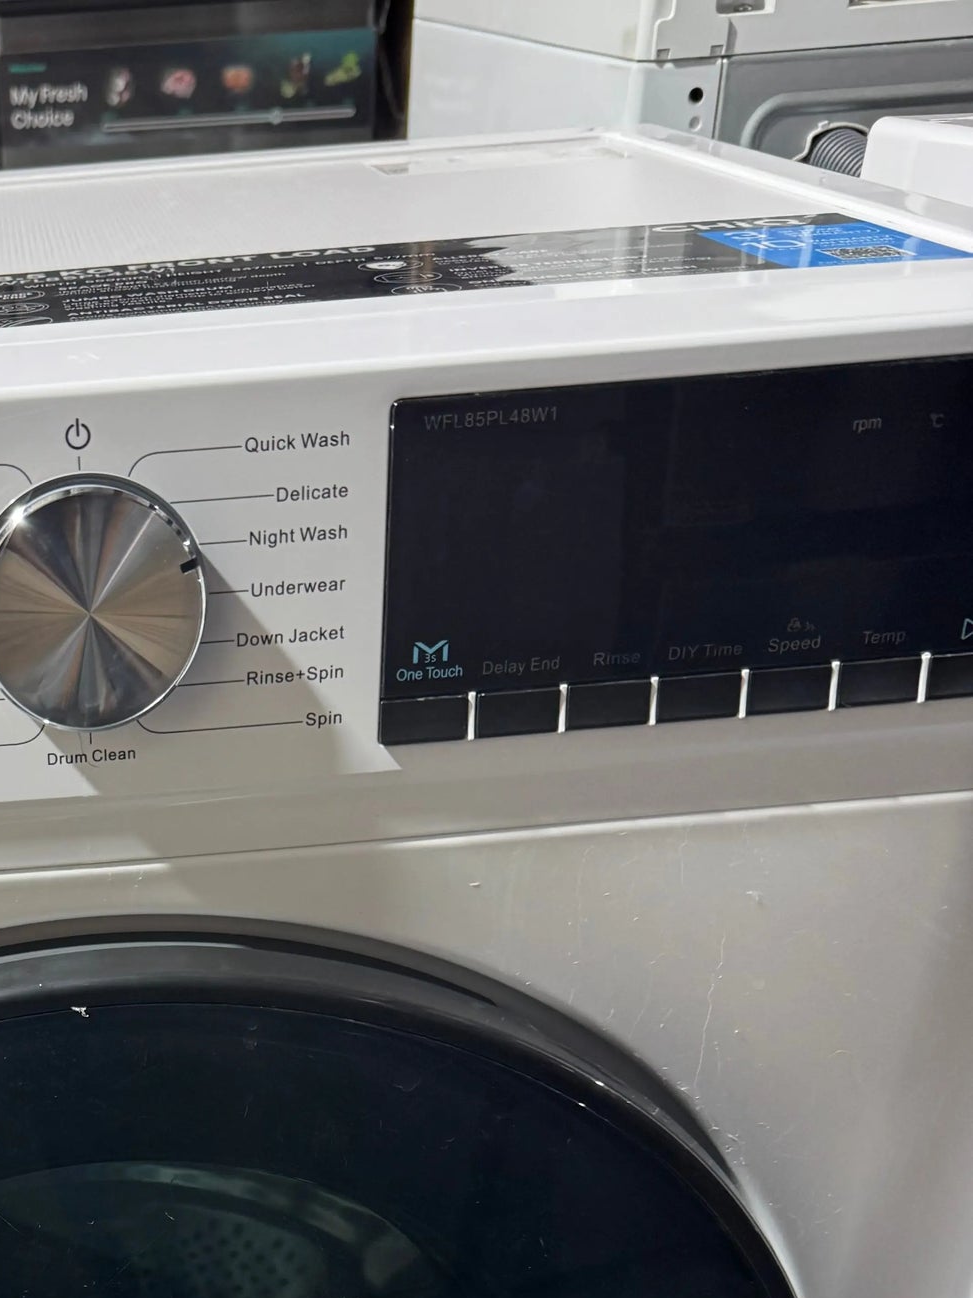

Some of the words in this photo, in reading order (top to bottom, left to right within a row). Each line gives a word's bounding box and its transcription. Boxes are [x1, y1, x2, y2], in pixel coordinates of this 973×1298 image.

[38, 83, 88, 104] Fresh
[11, 109, 74, 130] Choice
[59, 267, 115, 278] KG
[127, 255, 260, 272] FRONT
[270, 246, 376, 261] LOAD
[424, 406, 558, 432] WFL85PL48W1
[852, 415, 883, 434] rpm
[244, 434, 296, 455] Quick
[300, 430, 350, 450] Wash
[275, 482, 349, 503] Delicate
[249, 527, 297, 548] Night
[299, 523, 349, 544] Wash
[250, 577, 346, 598] Underwear
[236, 629, 285, 647] Down
[288, 625, 346, 644] Jacket
[767, 635, 822, 654] Speed
[863, 629, 907, 646] Temp
[593, 651, 641, 666] Rinse
[668, 645, 699, 661] DIY
[703, 641, 743, 659] Time
[246, 663, 345, 687] Rinse+Spin
[396, 668, 423, 682] One
[425, 665, 464, 680] Touch
[482, 659, 526, 676] Delay
[530, 656, 561, 672] End
[305, 709, 343, 730] Spin
[46, 749, 88, 766] Drum
[91, 746, 136, 764] Clean
